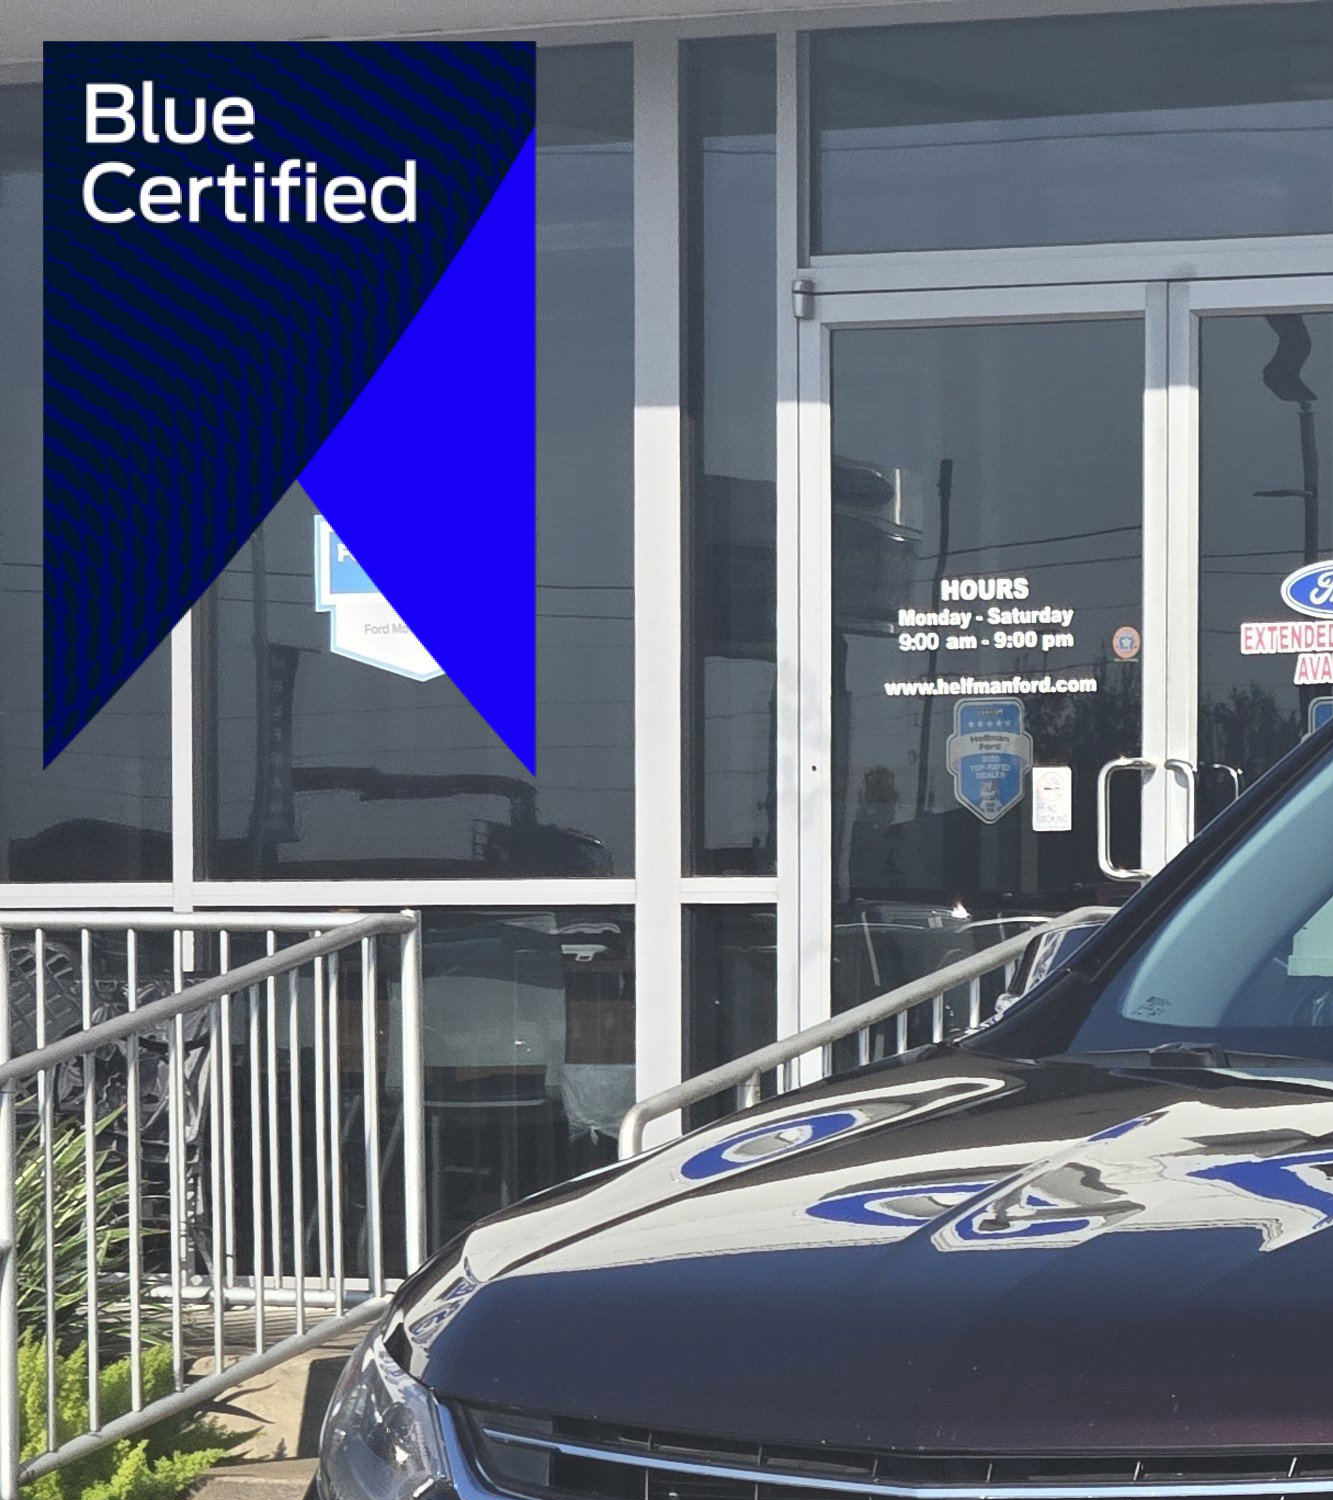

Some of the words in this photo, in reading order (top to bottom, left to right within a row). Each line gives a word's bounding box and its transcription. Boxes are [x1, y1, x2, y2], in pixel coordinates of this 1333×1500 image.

[940, 577, 1030, 601] HOURS
[898, 608, 972, 630] Monday
[987, 606, 1074, 627] Saturday
[364, 623, 390, 635] Ford
[898, 632, 940, 651] 9:00
[945, 634, 978, 650] am
[993, 631, 1038, 648] 9:00
[1041, 631, 1075, 652] pm
[884, 675, 1098, 696] www.helfmanford.com
